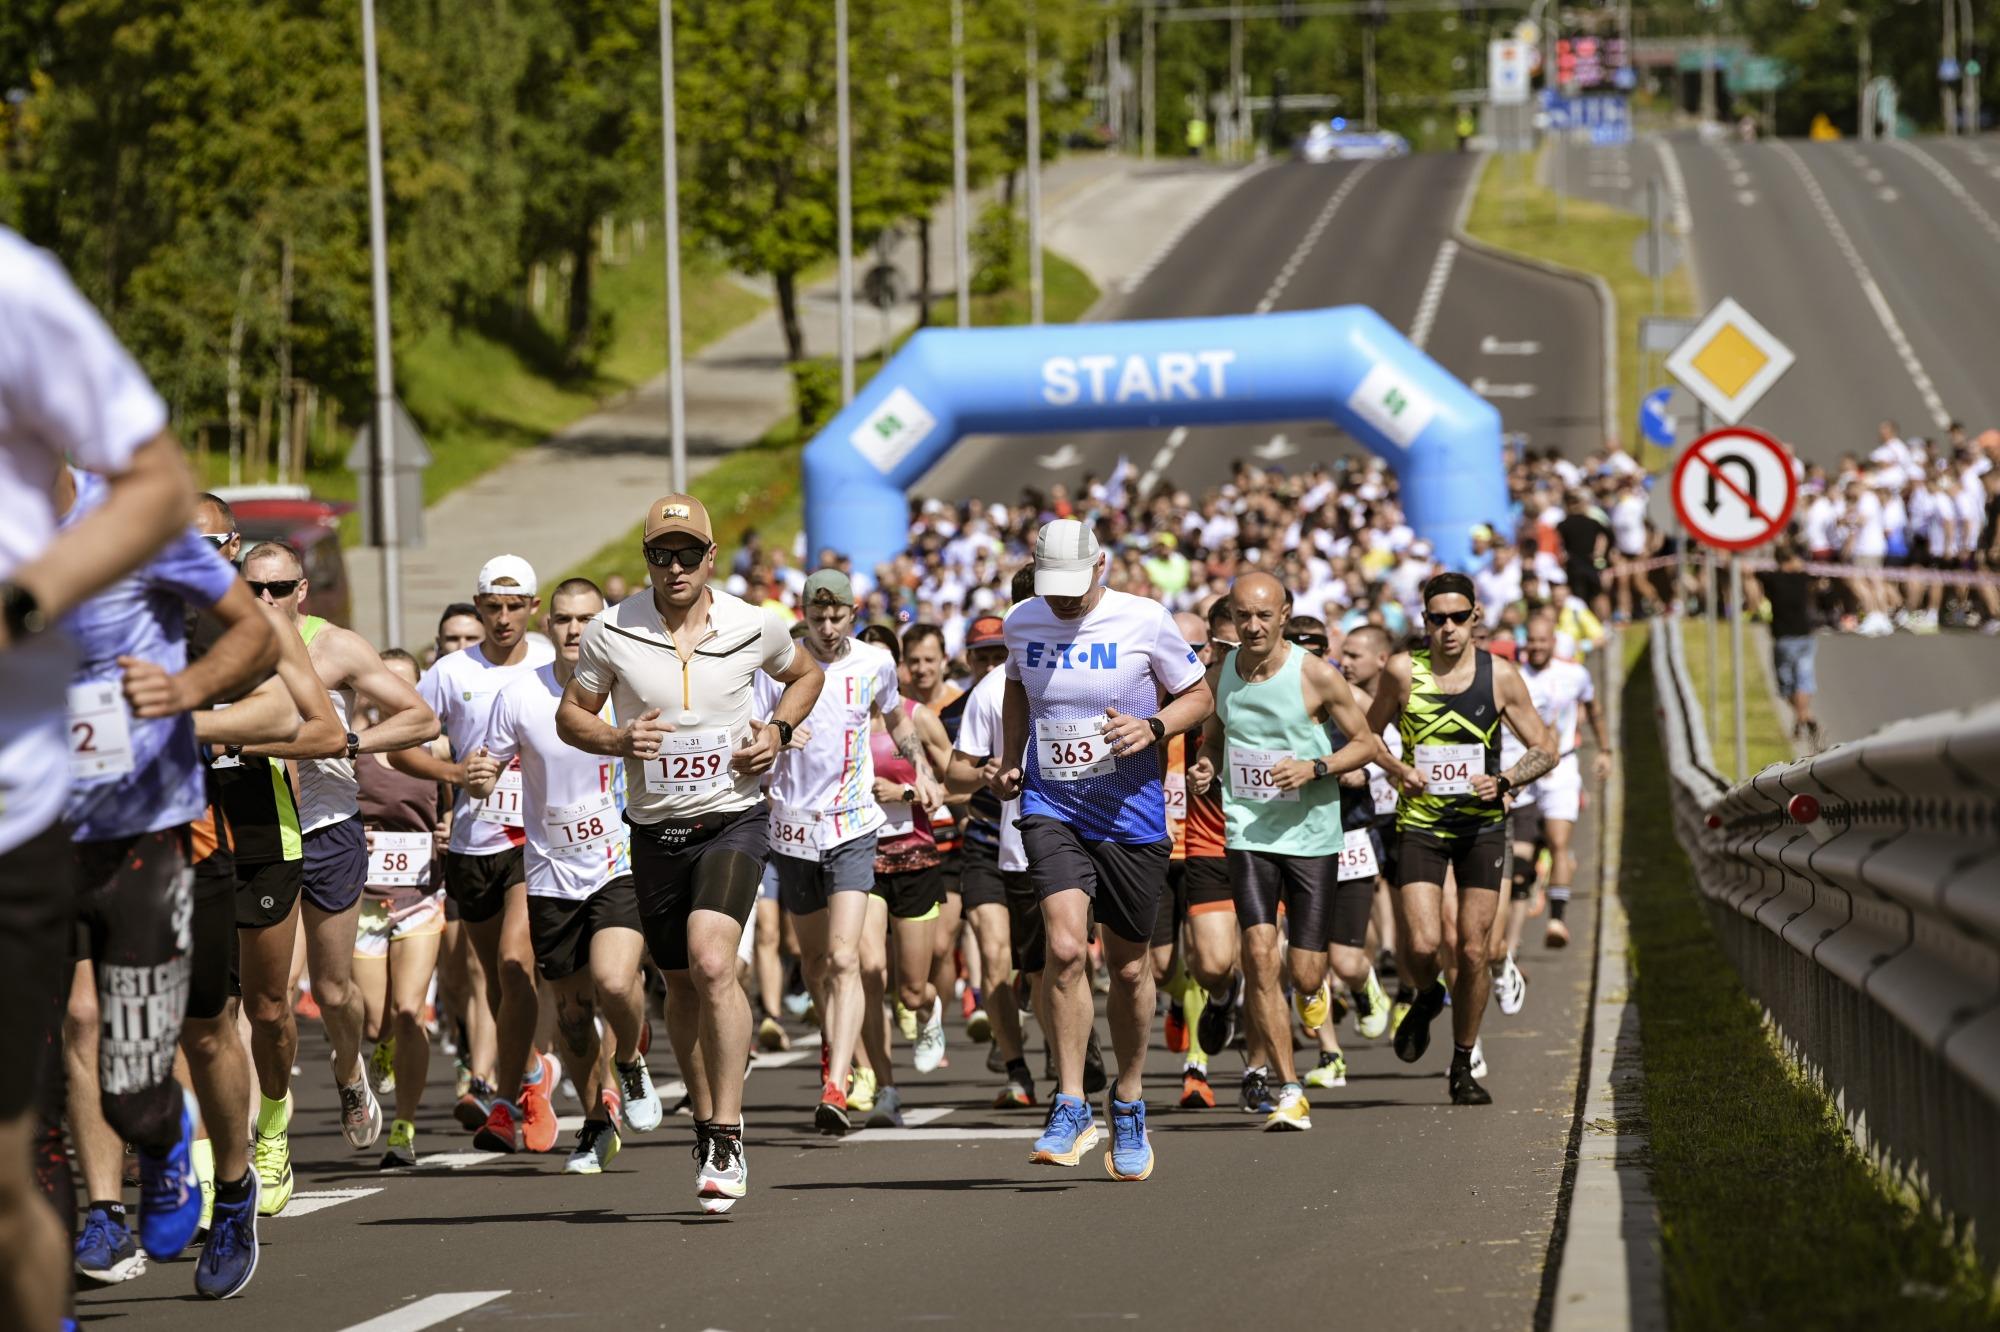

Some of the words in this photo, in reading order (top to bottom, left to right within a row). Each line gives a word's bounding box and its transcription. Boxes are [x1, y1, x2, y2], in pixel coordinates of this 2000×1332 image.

[1042, 350, 1235, 405] START
[1026, 642, 1117, 669] EATON
[690, 738, 700, 746] 31
[1051, 741, 1093, 765] 363
[658, 754, 721, 778] 1259
[1431, 763, 1469, 781] 504
[562, 817, 604, 843] 158
[774, 820, 806, 844] 384
[382, 853, 408, 871] 58
